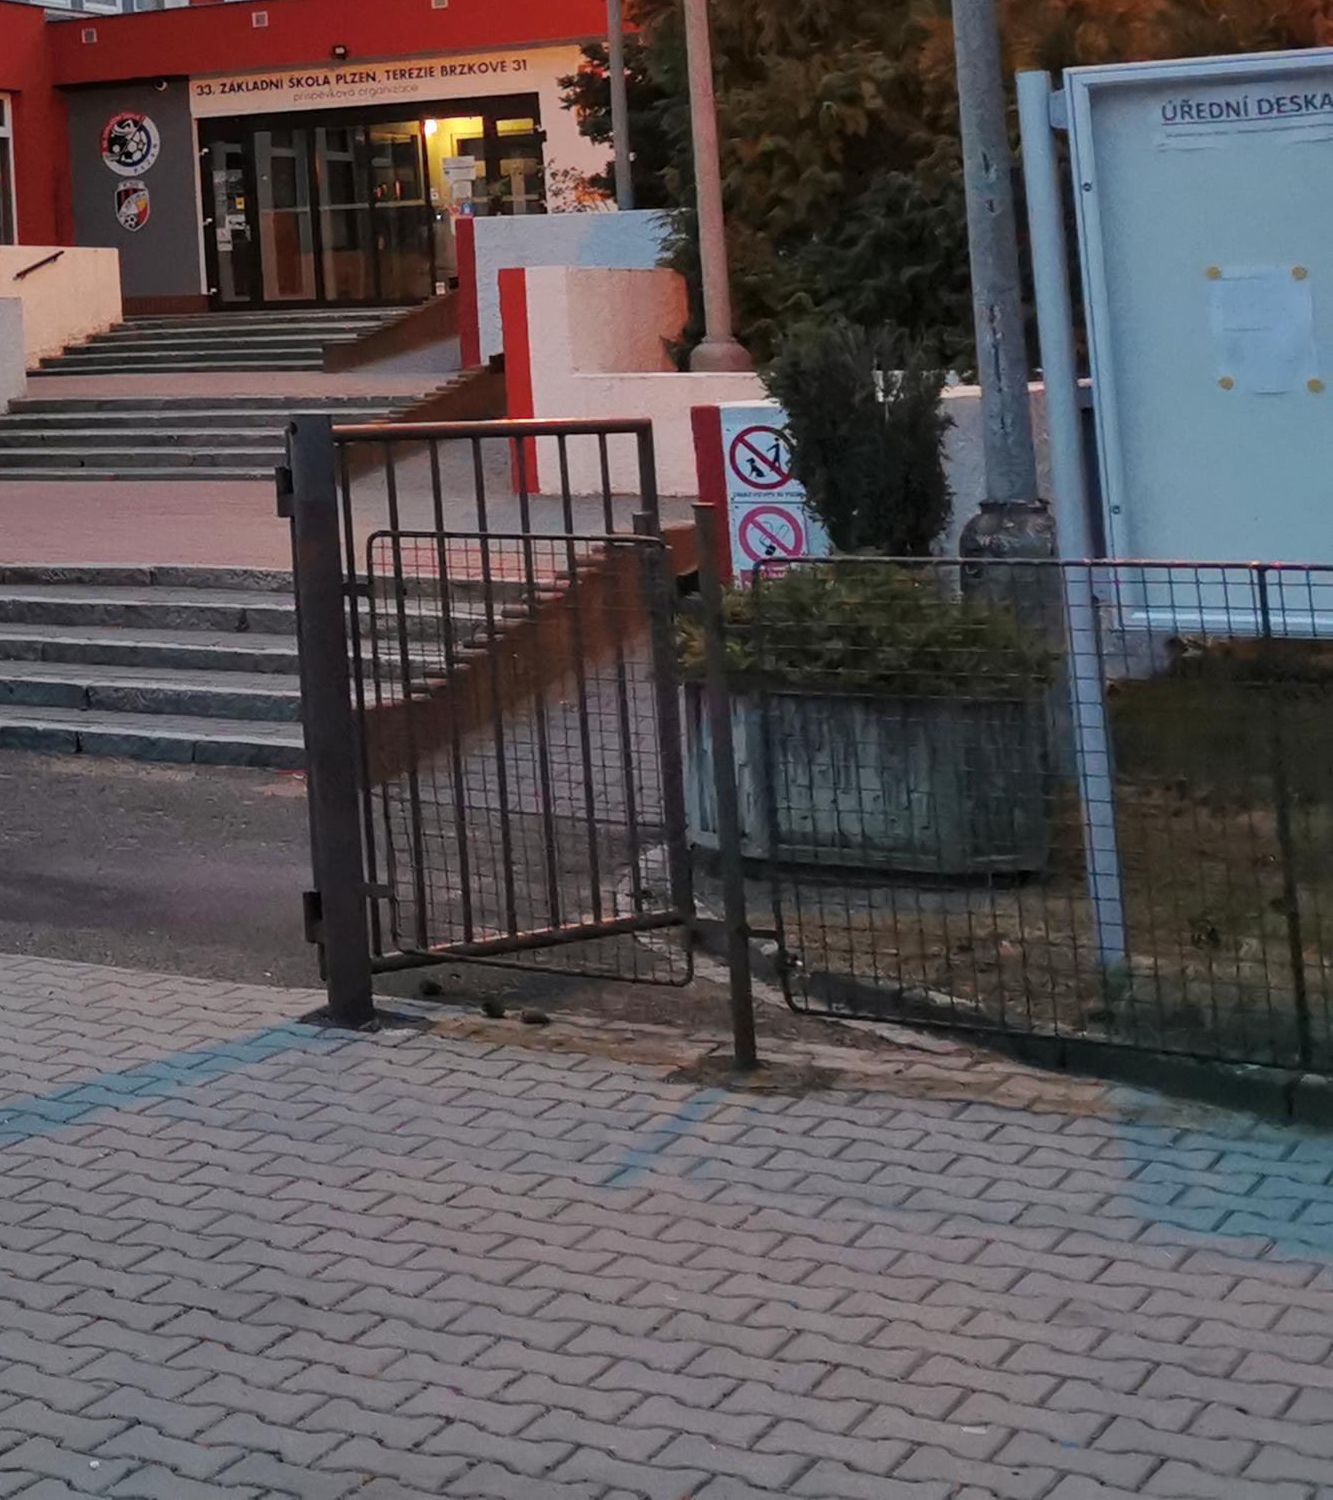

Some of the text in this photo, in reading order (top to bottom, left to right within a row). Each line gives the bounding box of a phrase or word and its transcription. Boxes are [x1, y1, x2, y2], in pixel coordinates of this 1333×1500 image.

[385, 66, 435, 81] TEREZIE
[512, 59, 528, 72] 31
[1161, 92, 1333, 122] ÚŘEDNÍ DESKA
